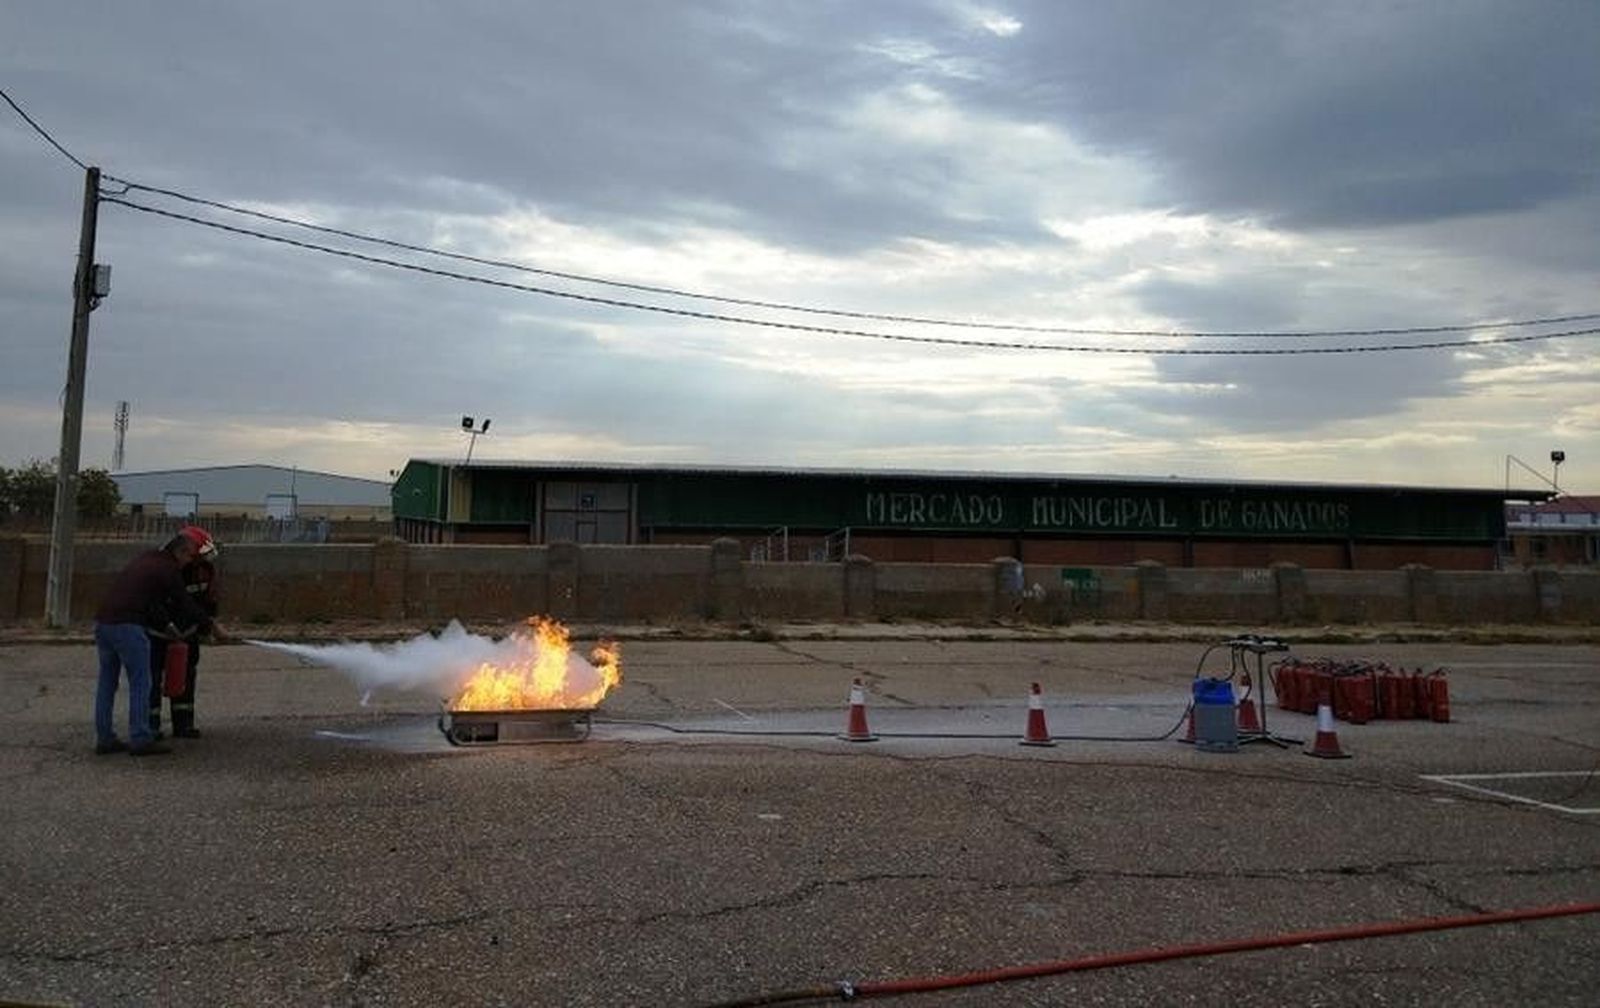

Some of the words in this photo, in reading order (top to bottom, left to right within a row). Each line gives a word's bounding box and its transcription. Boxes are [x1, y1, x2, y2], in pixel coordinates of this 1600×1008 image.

[866, 493, 1003, 524] MERCADO
[1031, 496, 1177, 527] MUNICIPAL
[1200, 499, 1233, 528] DE
[1241, 500, 1351, 530] GANADOS
